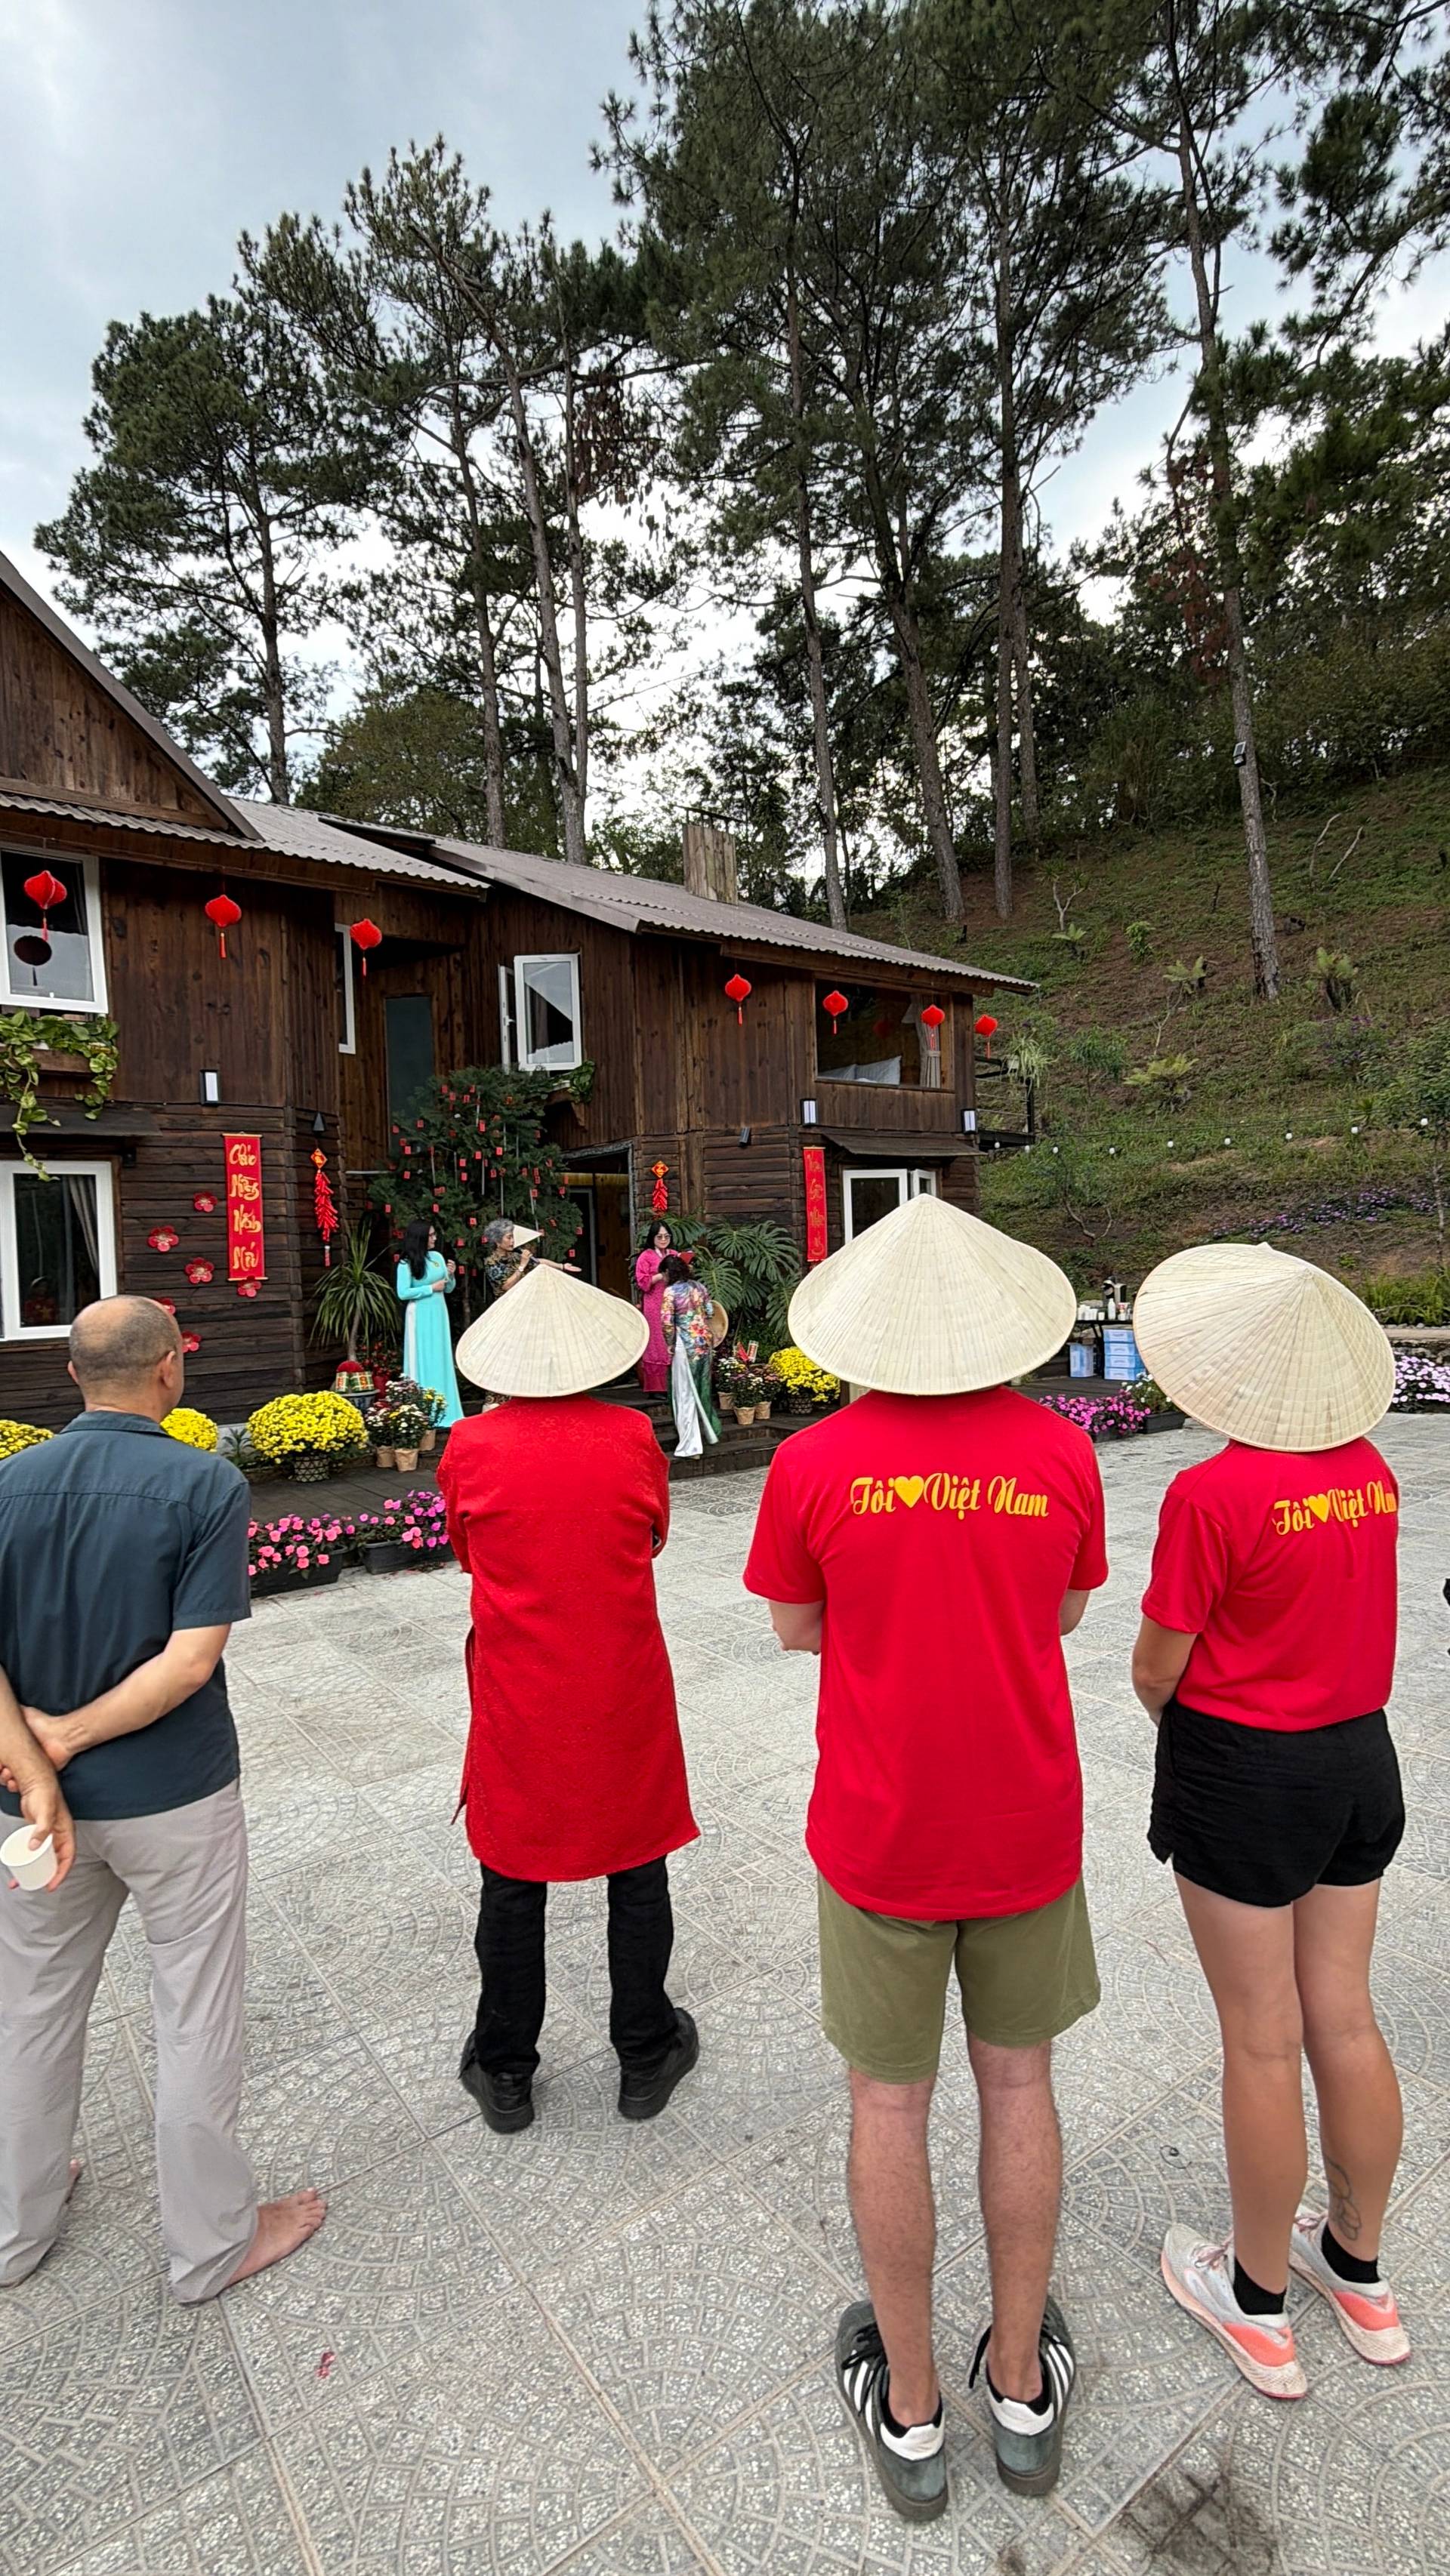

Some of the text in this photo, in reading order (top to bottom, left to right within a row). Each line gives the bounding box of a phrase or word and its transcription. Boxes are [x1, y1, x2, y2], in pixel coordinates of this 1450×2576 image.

[850, 1472, 1050, 1521] Tôi Việt Nam
[1272, 1498, 1315, 1536] Tôi
[1327, 1488, 1368, 1528] Việt
